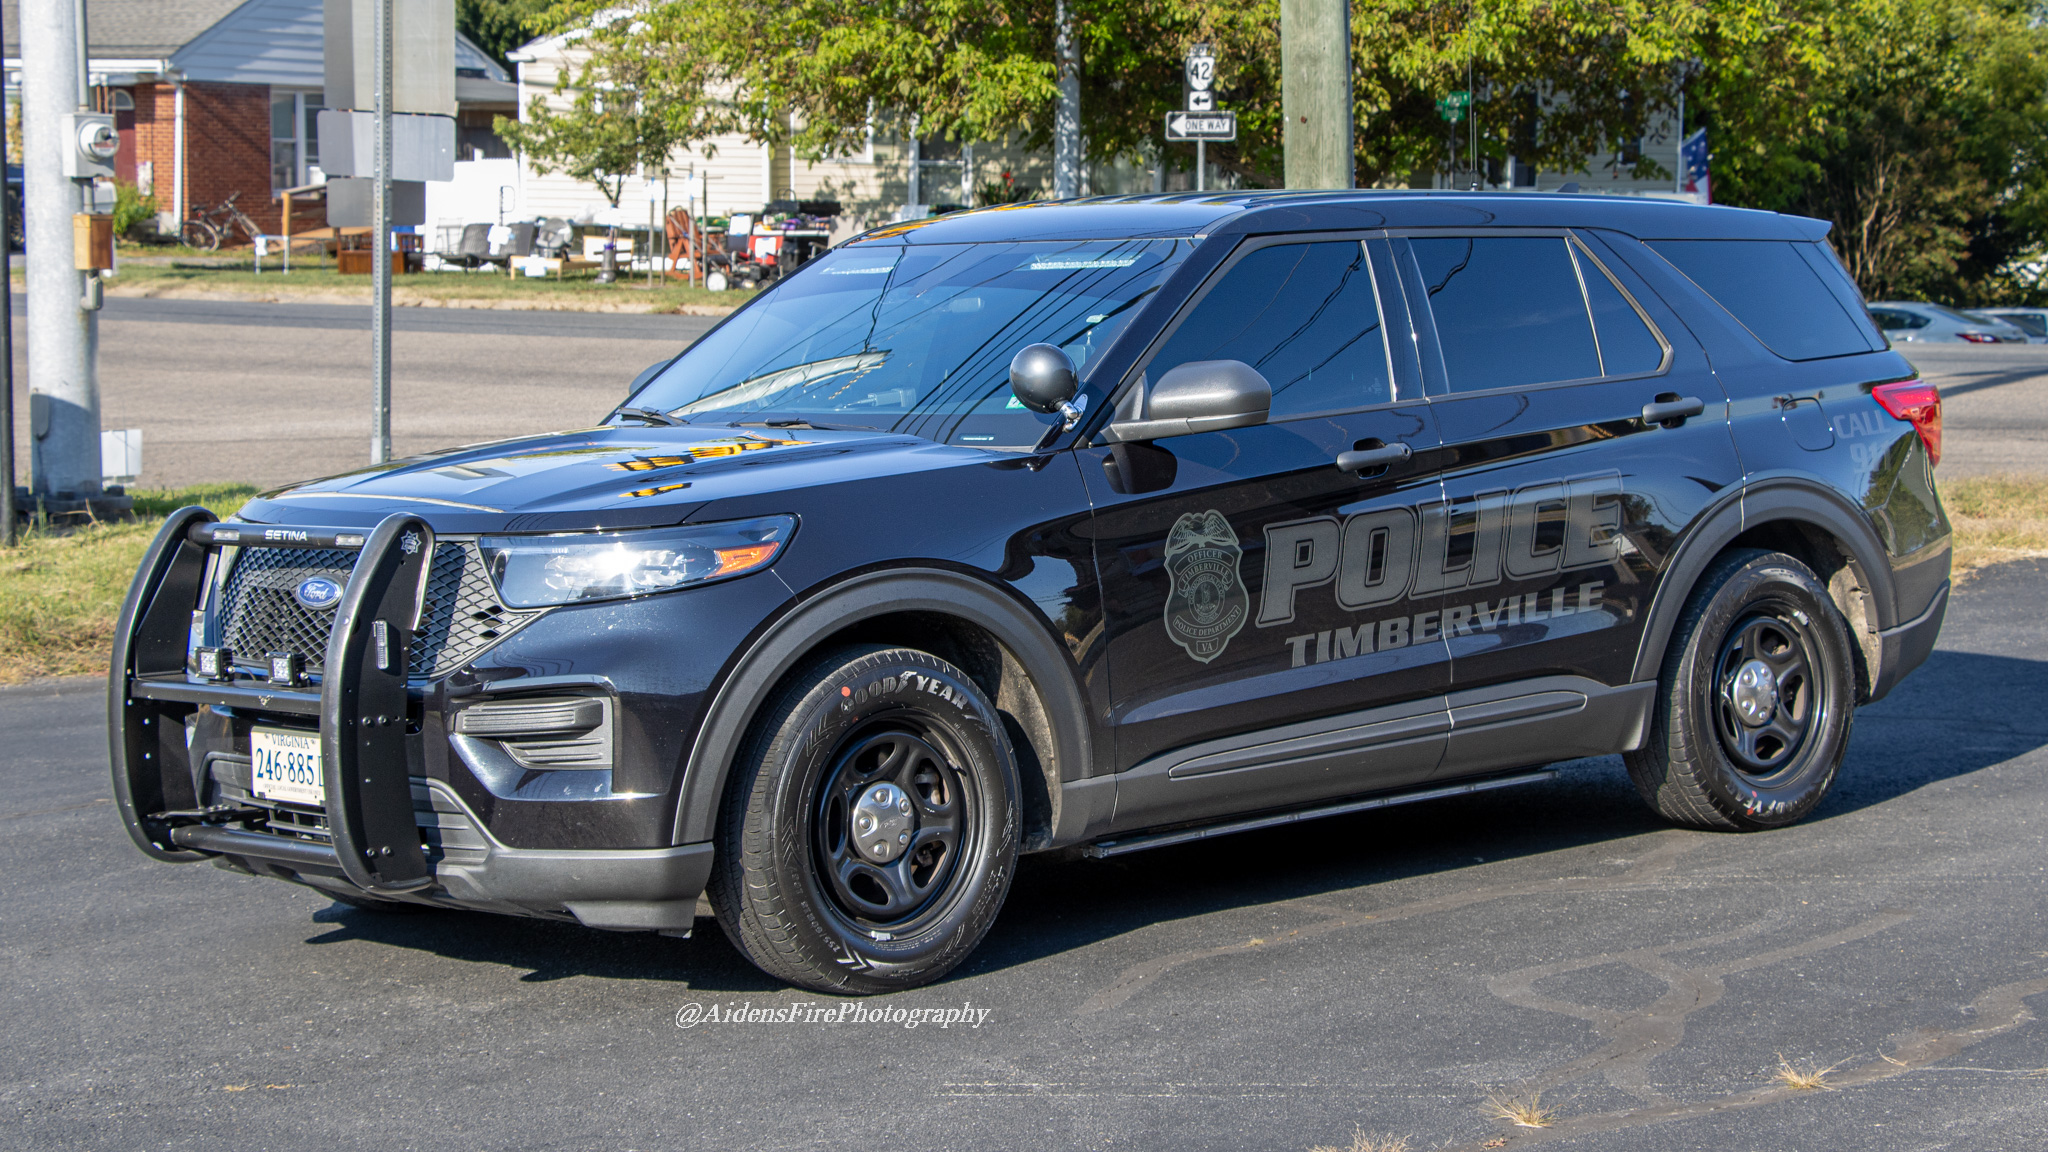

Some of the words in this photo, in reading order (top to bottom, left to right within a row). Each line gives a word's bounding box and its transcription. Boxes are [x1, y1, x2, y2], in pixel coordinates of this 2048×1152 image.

[1190, 61, 1210, 80] 42
[1185, 120, 1204, 131] ONE
[1207, 119, 1227, 130] WAY
[1833, 409, 1891, 439] CALL
[264, 529, 308, 542] SETINA
[1187, 550, 1223, 563] OFFICER
[1255, 468, 1624, 628] POLICE
[1181, 562, 1230, 584] TIMBERVILLE
[303, 582, 330, 600] Ford
[1175, 619, 1199, 636] POLICE
[1198, 608, 1241, 637] DEPARTMENT
[1285, 580, 1604, 668] TIMBERVILLE
[1201, 642, 1213, 652] VA
[271, 733, 310, 749] VIRGINIA
